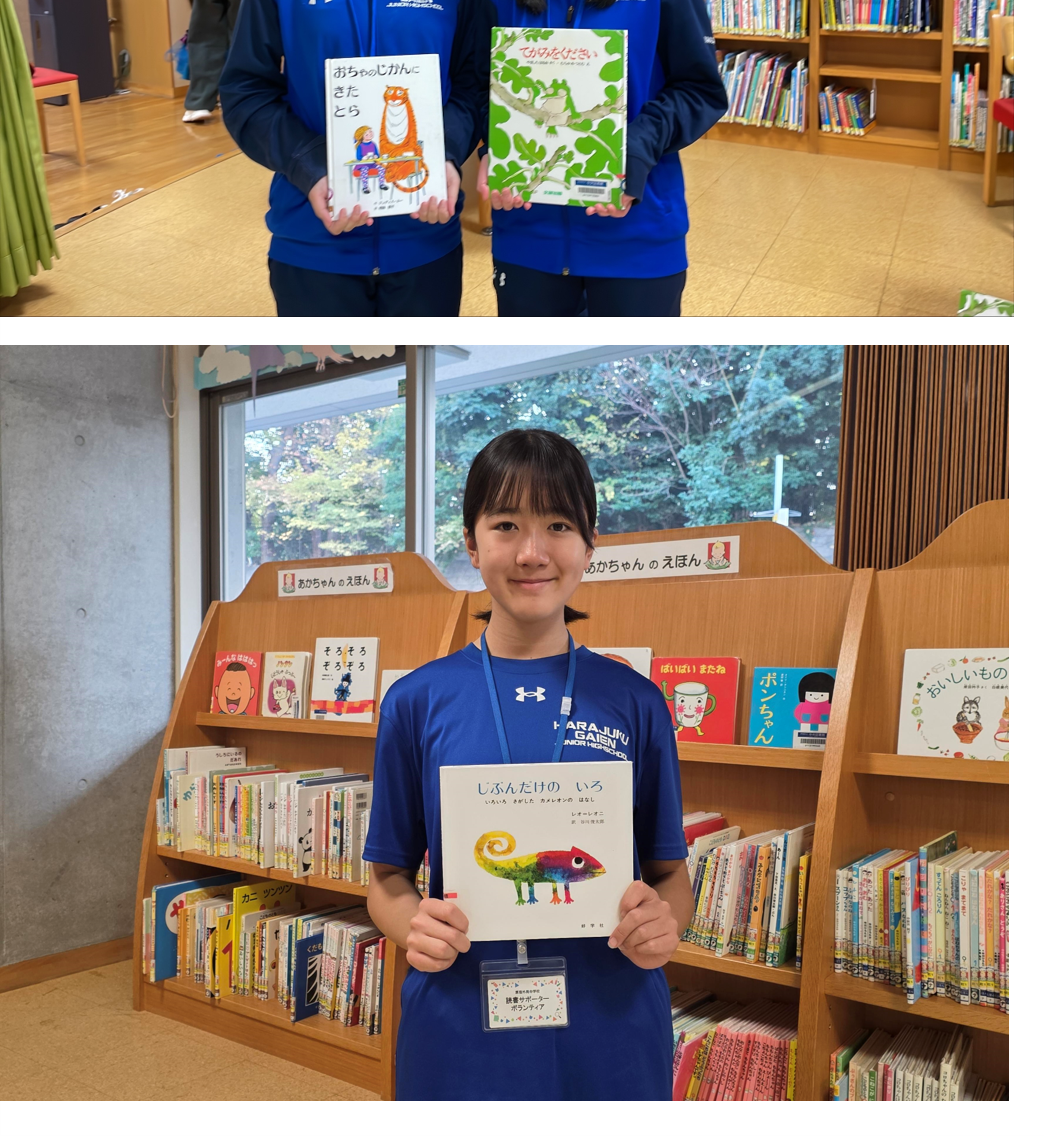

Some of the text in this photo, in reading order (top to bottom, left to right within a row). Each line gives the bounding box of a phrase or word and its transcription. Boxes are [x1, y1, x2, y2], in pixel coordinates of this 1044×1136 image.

[519, 46, 598, 60] てがみをください
[333, 62, 421, 79] おちゃのじかんに
[333, 85, 359, 99] きた
[333, 104, 360, 118] とら
[584, 554, 701, 575] あかちゃん の えほん
[297, 577, 336, 589] あかちゃん
[346, 575, 371, 586] えほん
[699, 664, 727, 674] またね
[926, 666, 1008, 698] おいしいもの
[754, 672, 778, 745] ポンちゃん
[574, 730, 617, 749] GAIEN
[478, 780, 603, 795] じぶんだけの いろ
[241, 884, 293, 904] カニ ツンツン
[505, 996, 550, 1005] 読書サポーター
[511, 1004, 546, 1013] ボランティア
